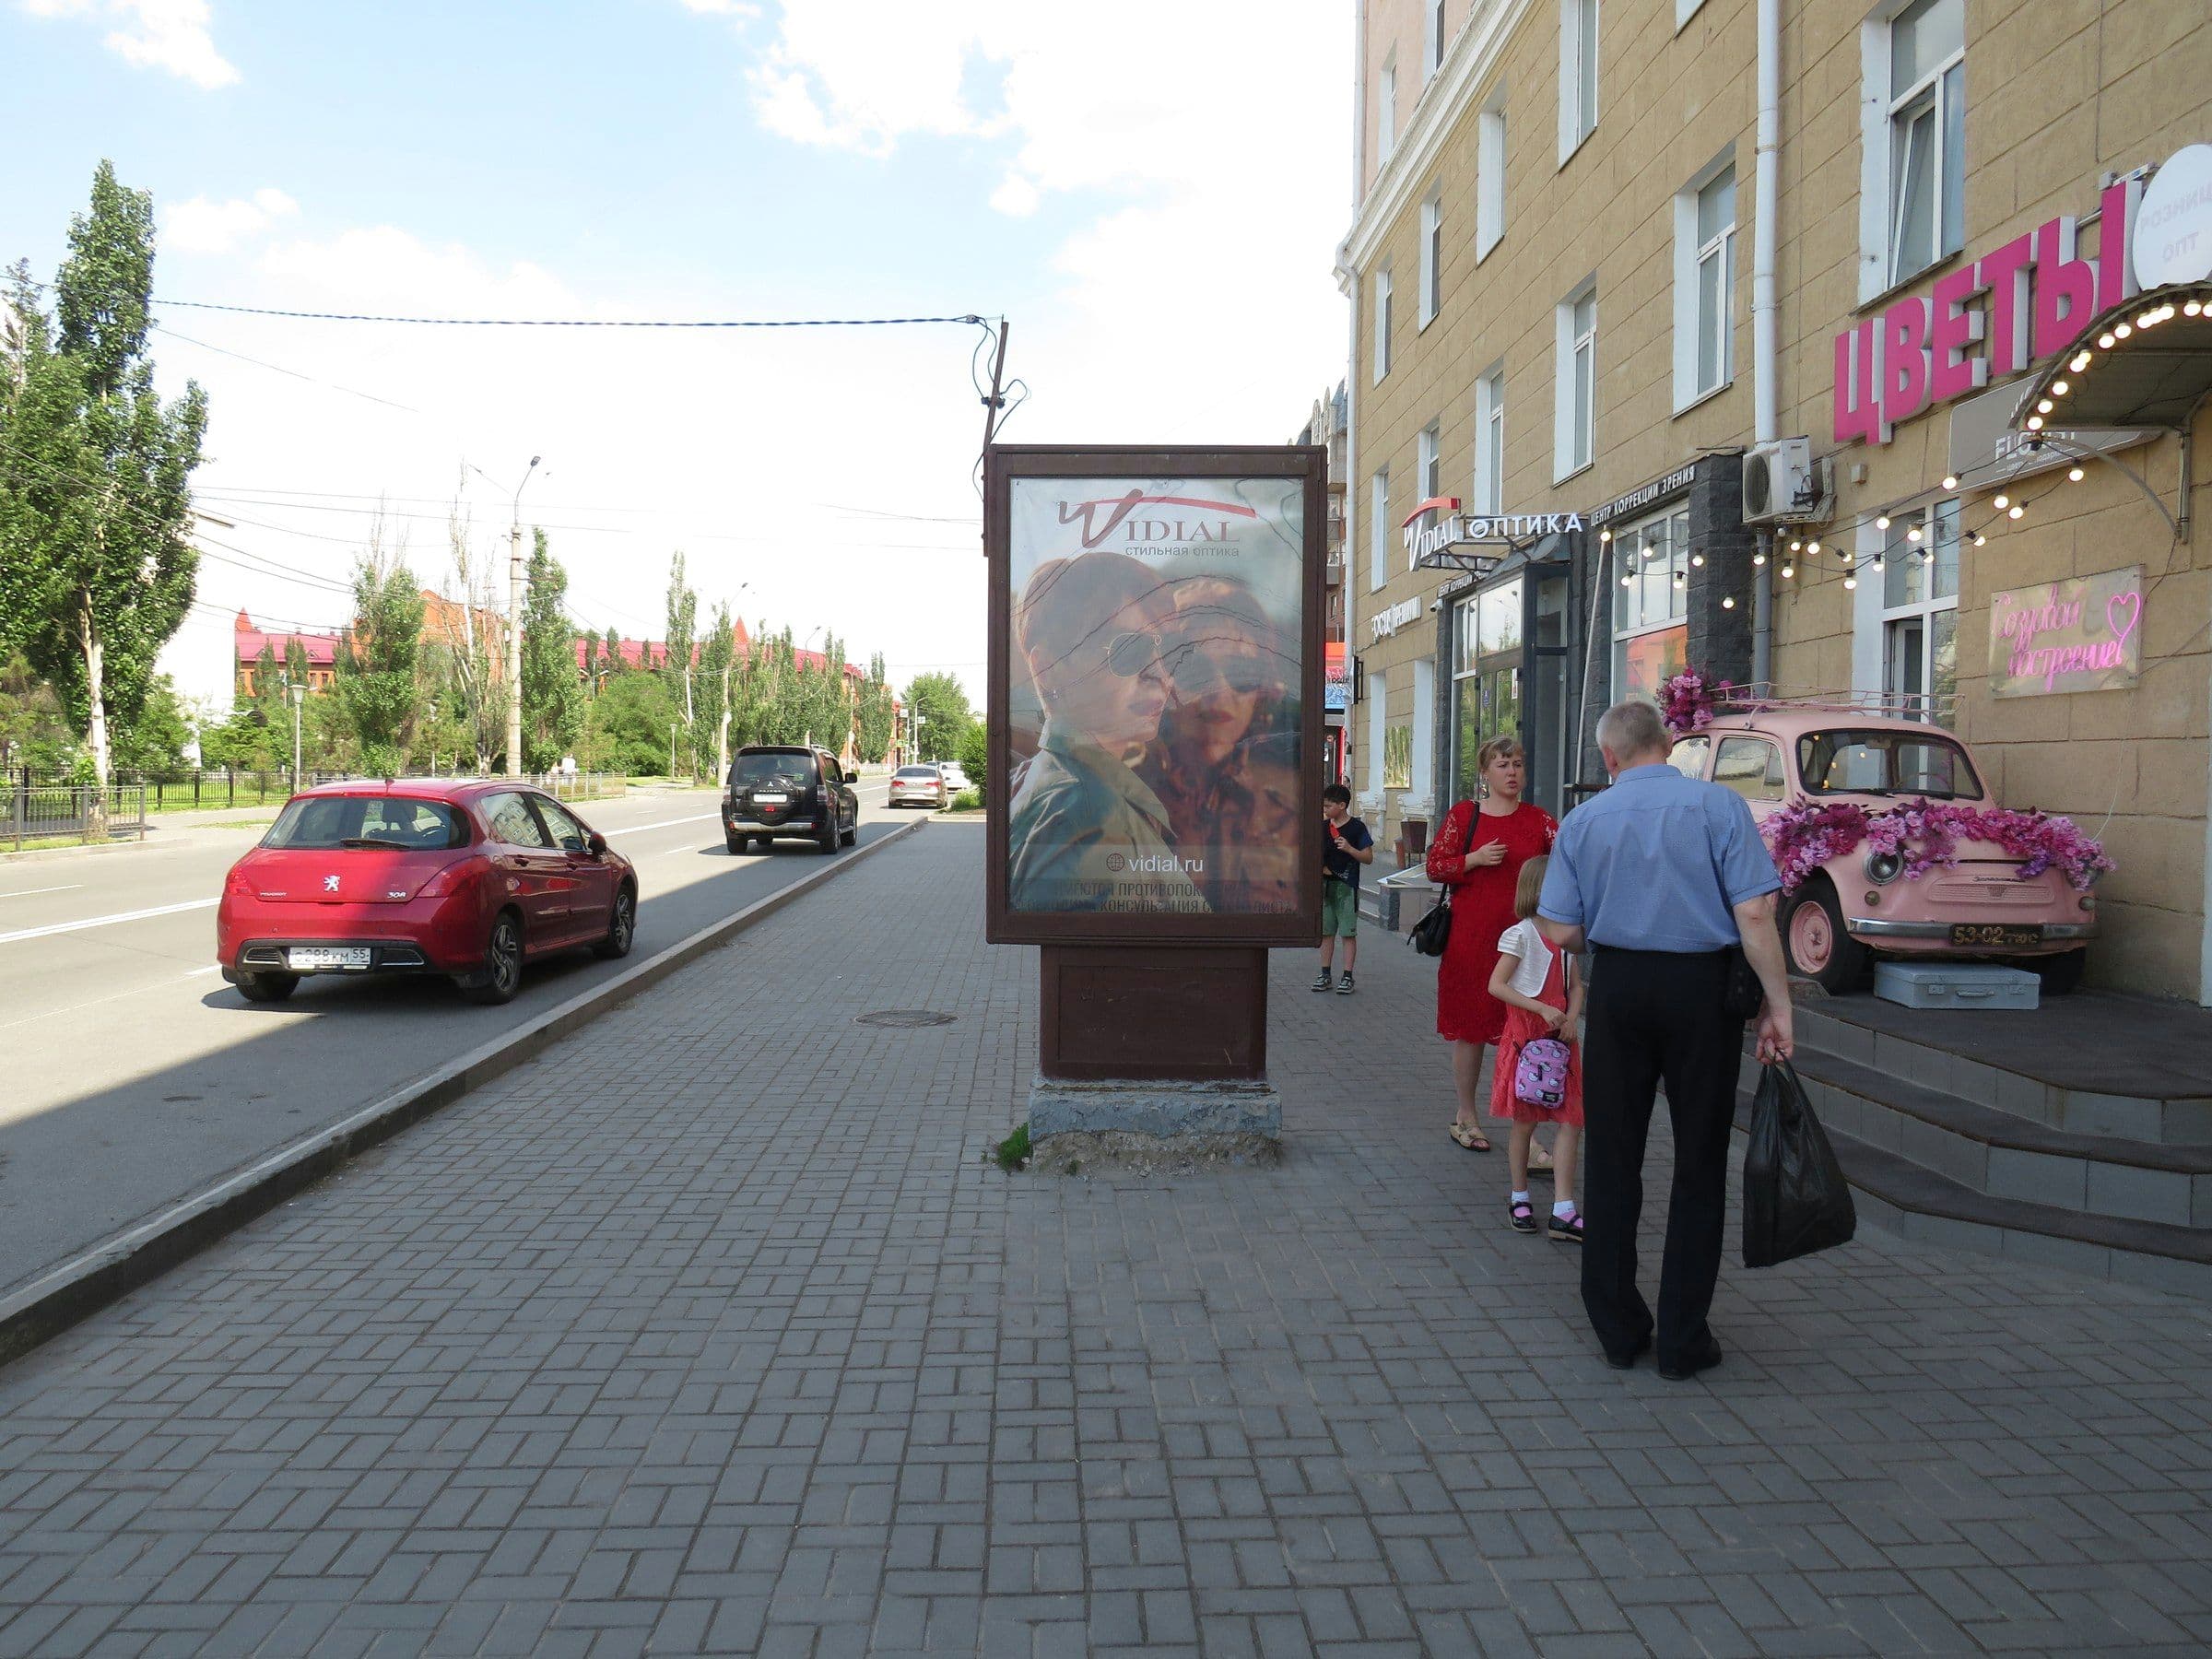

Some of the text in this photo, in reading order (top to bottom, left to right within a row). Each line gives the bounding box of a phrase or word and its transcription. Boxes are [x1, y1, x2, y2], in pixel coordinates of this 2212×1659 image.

[1834, 181, 2135, 445] ЦВЕТЫ
[1614, 483, 1659, 517] КОРРЕКЦИИ
[1662, 465, 1695, 495] ЗРЕНИЯ
[1469, 512, 1583, 539] ОПТИКА
[1124, 546, 1240, 558] стильная оптика
[1128, 855, 1204, 872] vidial.ru
[352, 948, 366, 959] 55
